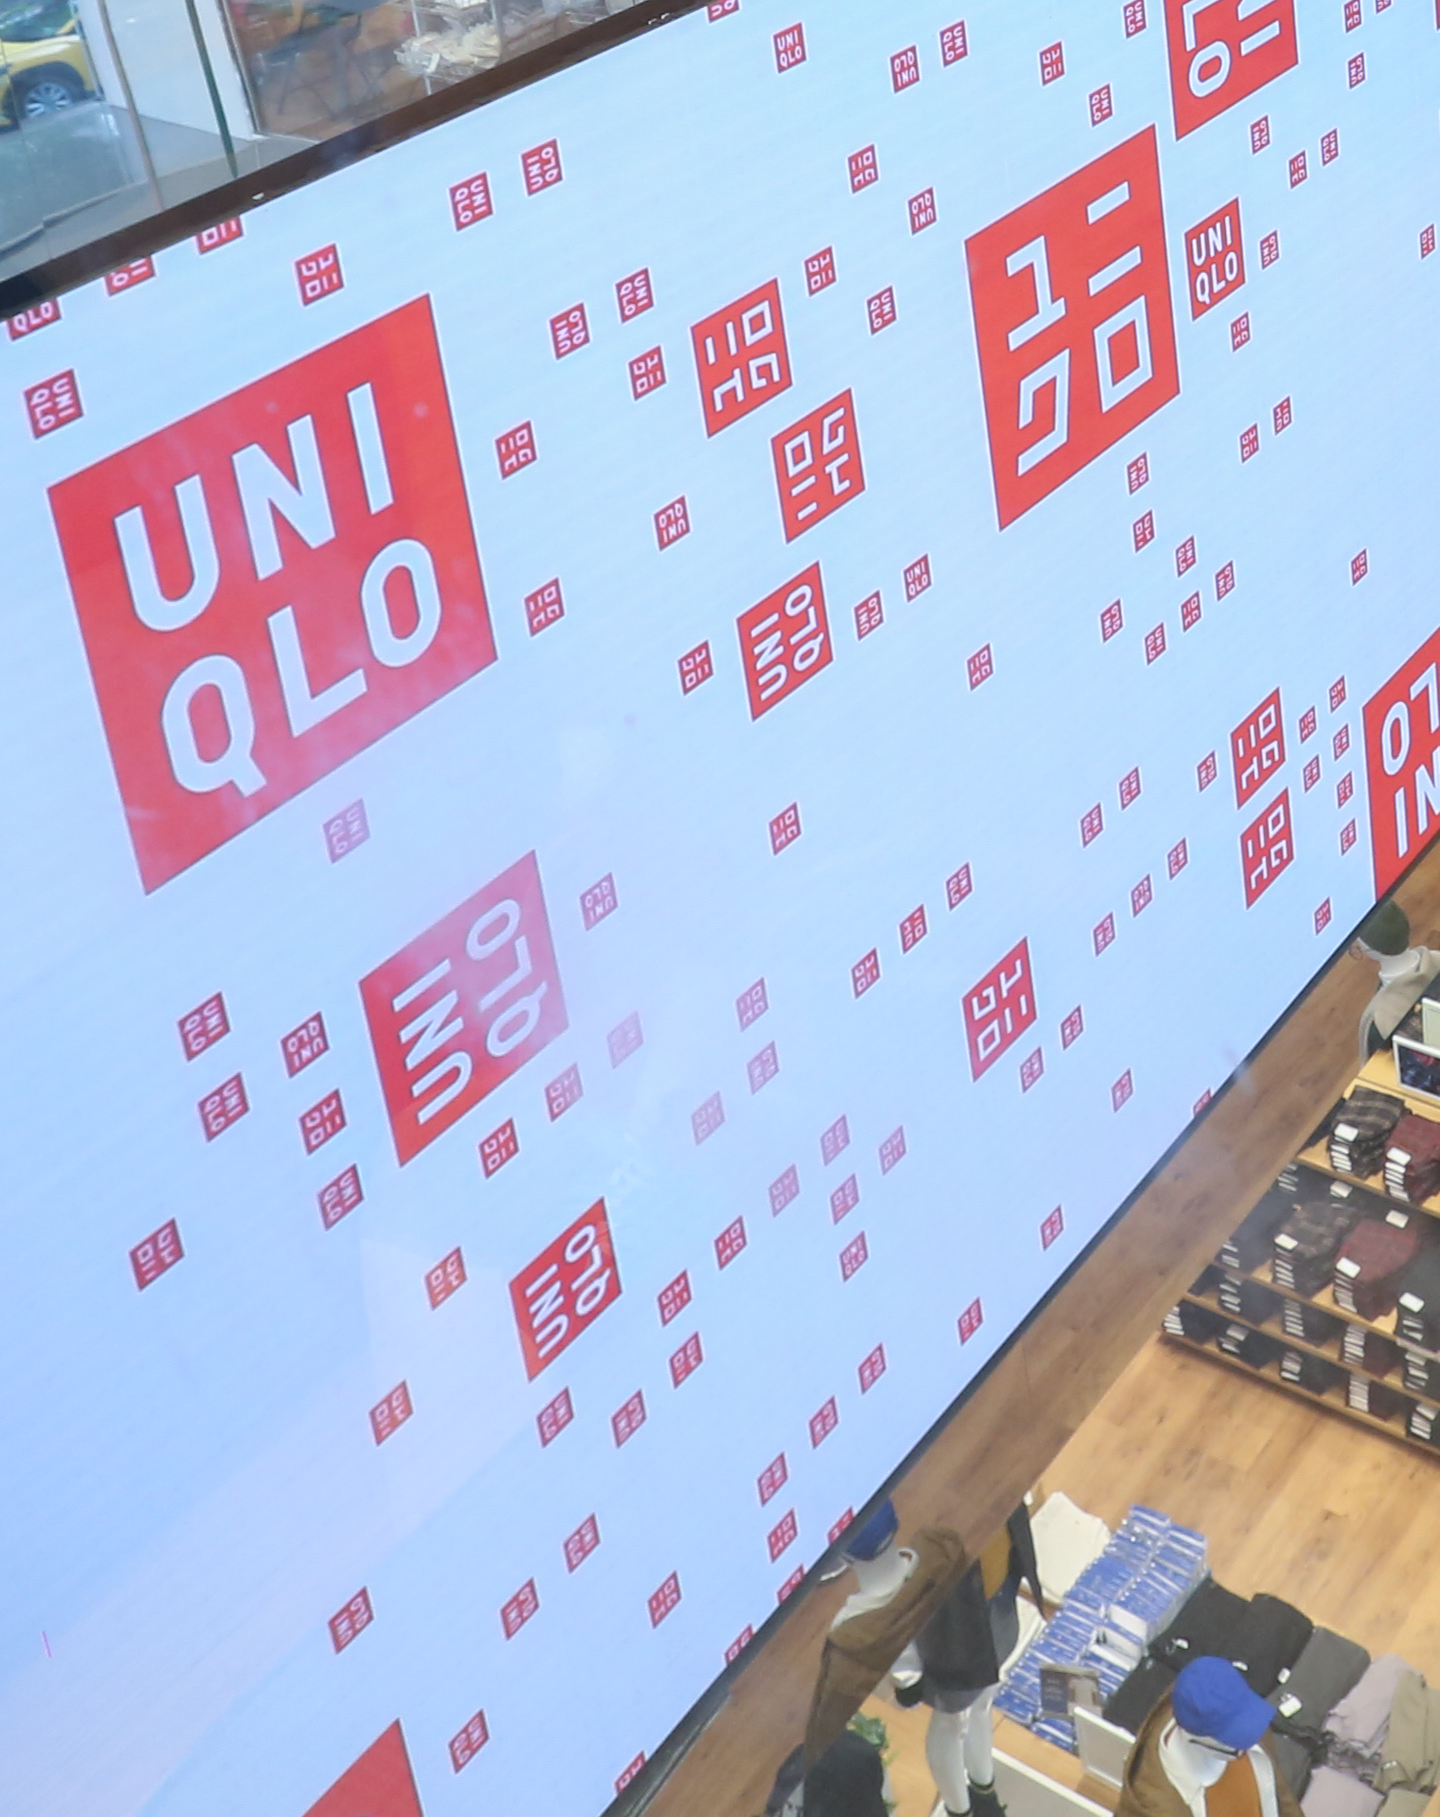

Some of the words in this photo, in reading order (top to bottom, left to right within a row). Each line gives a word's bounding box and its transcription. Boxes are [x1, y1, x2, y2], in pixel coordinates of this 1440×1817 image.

[1192, 215, 1231, 265] UNI
[1196, 251, 1238, 304] QLO
[13, 301, 55, 332] QLO
[117, 383, 395, 631] UNI
[162, 539, 443, 797] QLO
[750, 611, 787, 701] UNI
[784, 584, 824, 672] QLO
[467, 896, 549, 1058] QLO
[394, 954, 474, 1125] UNI
[525, 1262, 568, 1358] UNI
[565, 1226, 611, 1317] QLO
